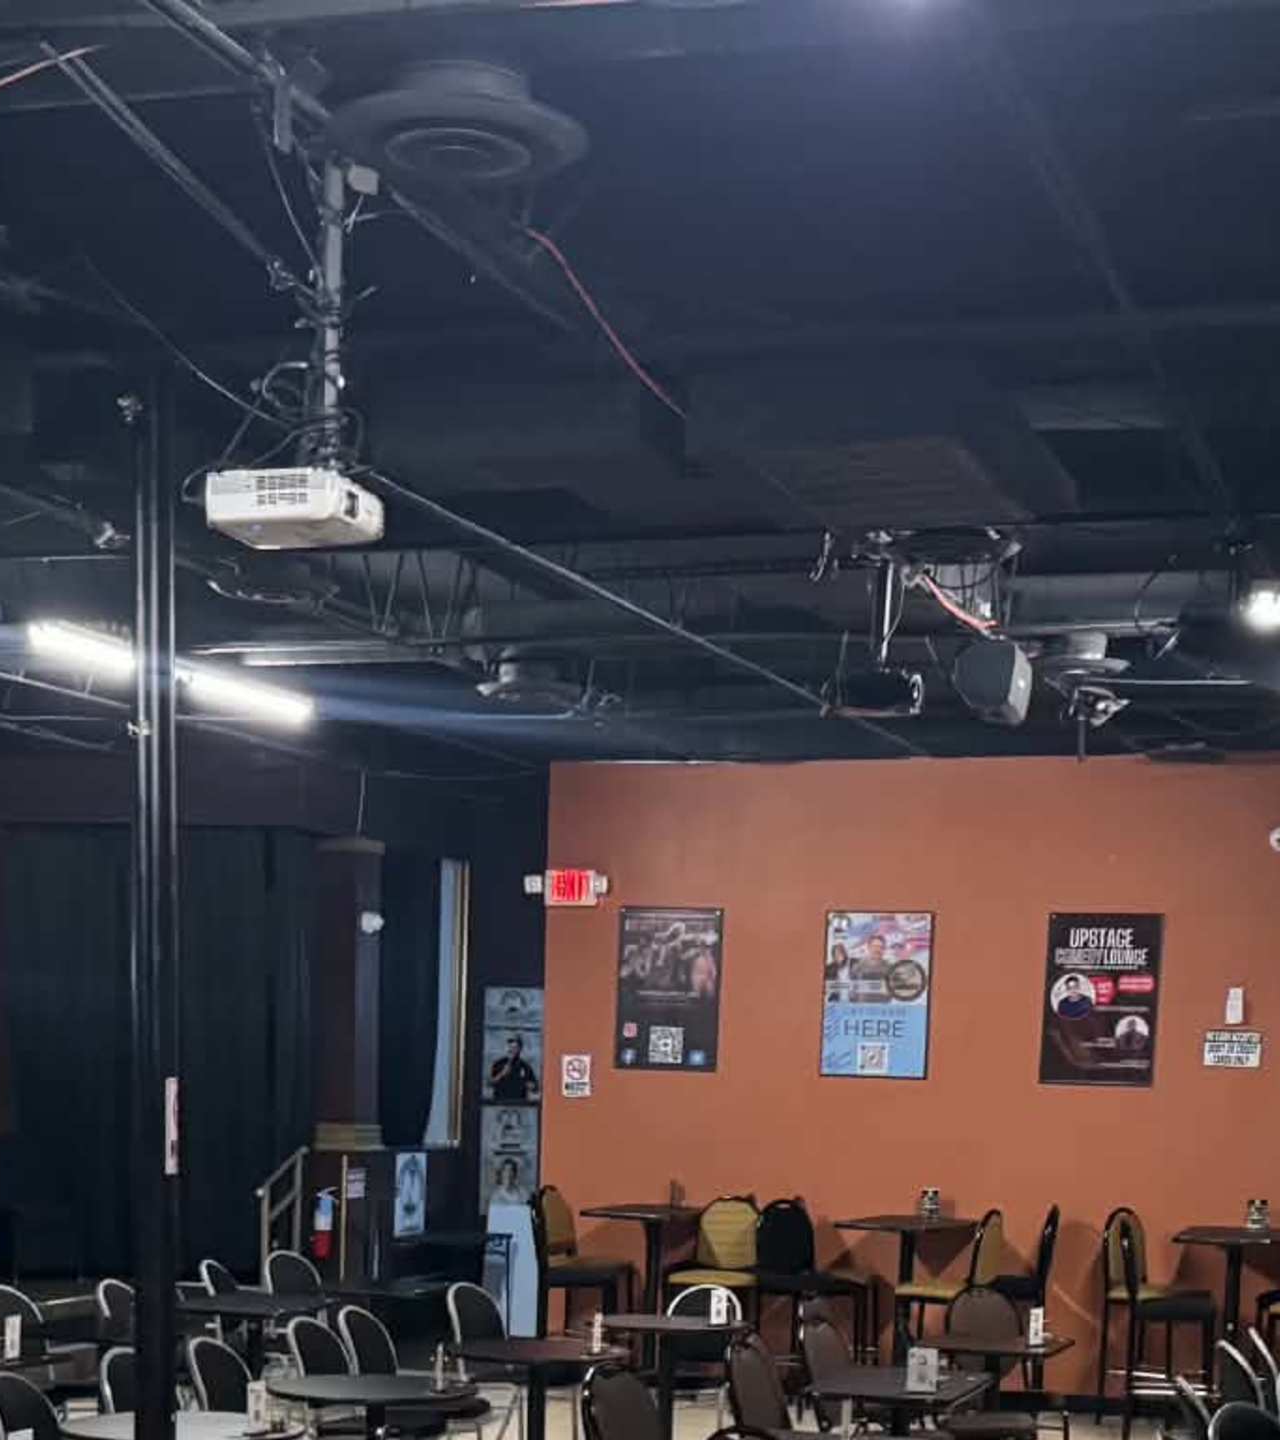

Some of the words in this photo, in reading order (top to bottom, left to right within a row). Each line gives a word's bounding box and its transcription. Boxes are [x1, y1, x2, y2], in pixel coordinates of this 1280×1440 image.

[552, 870, 590, 901] EXIT
[1069, 927, 1134, 947] UPSTAGE
[1103, 948, 1149, 965] LOUNGE
[844, 1019, 907, 1038] HERE
